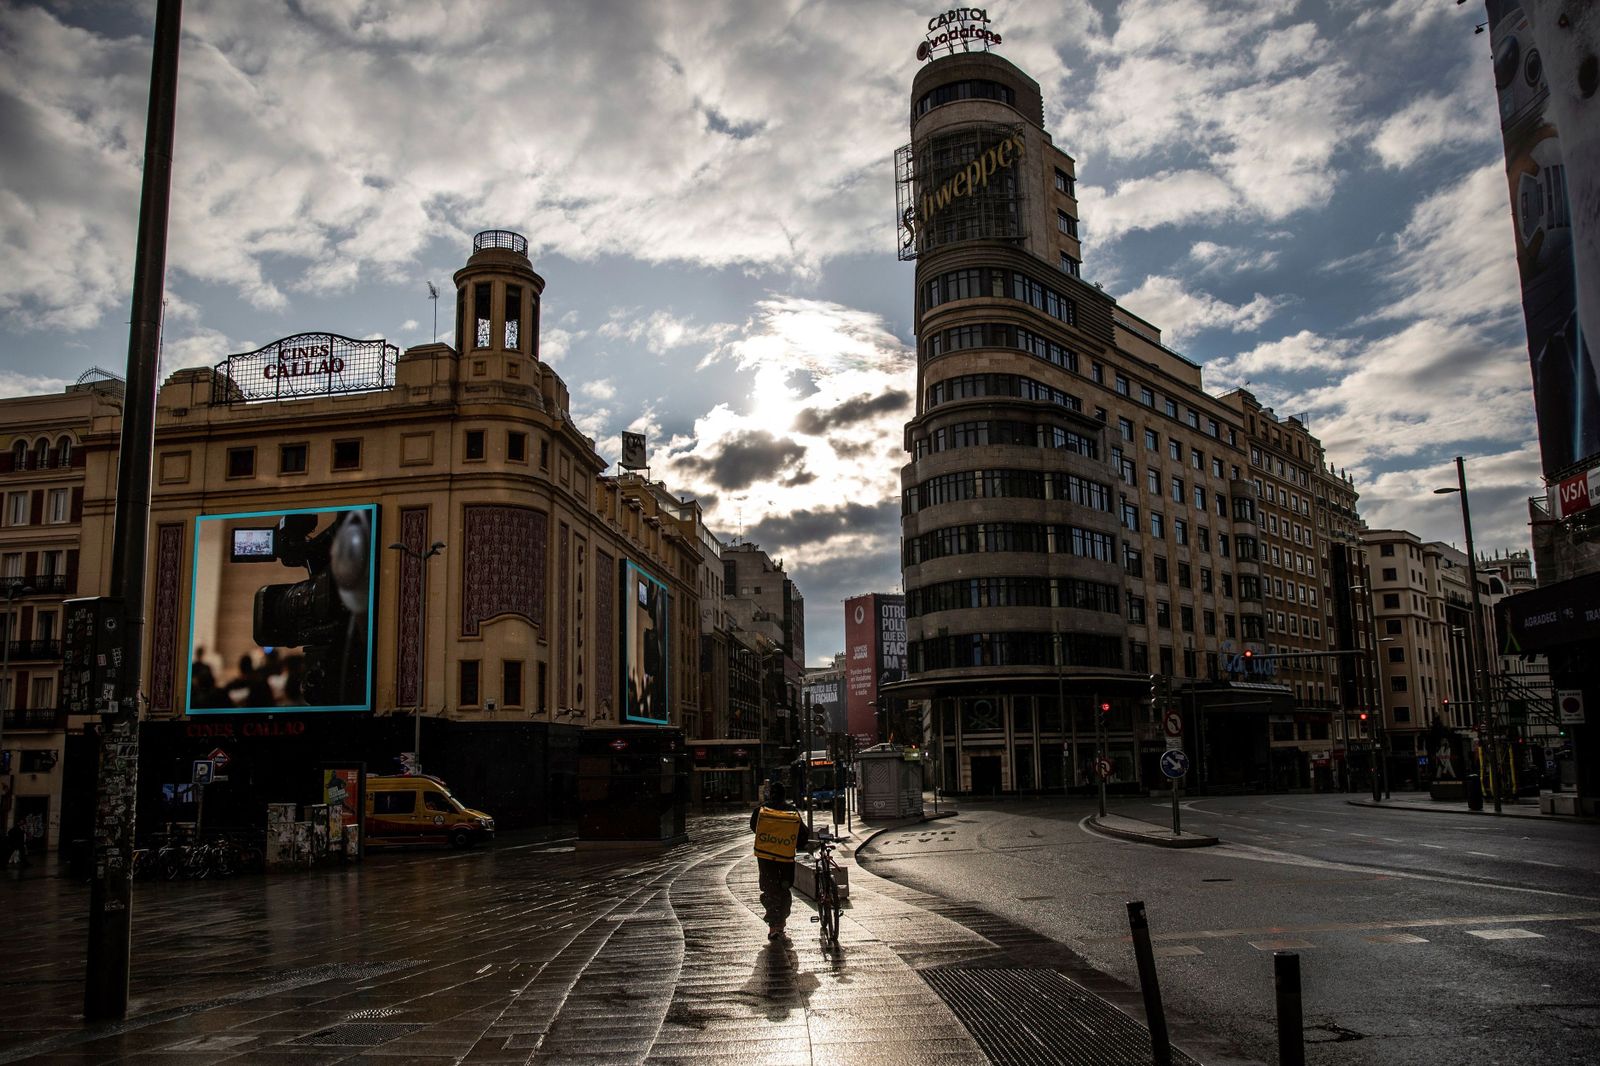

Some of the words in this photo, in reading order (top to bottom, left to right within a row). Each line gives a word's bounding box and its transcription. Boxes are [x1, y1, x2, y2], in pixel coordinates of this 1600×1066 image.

[928, 8, 991, 31] CAPITOL
[930, 24, 1002, 48] vodafone
[902, 126, 1025, 249] Shweppes
[279, 345, 329, 361] CINES
[264, 357, 344, 379] CALLAO
[1561, 480, 1587, 503] VSA
[882, 604, 906, 618] OTRO
[1524, 611, 1557, 628] AGRADECE
[1584, 608, 1600, 622] TRA
[576, 545, 584, 703] CALLAO
[883, 632, 896, 641] QUE
[897, 631, 906, 641] ES
[884, 655, 899, 669] DA
[759, 832, 791, 846] Glovo
